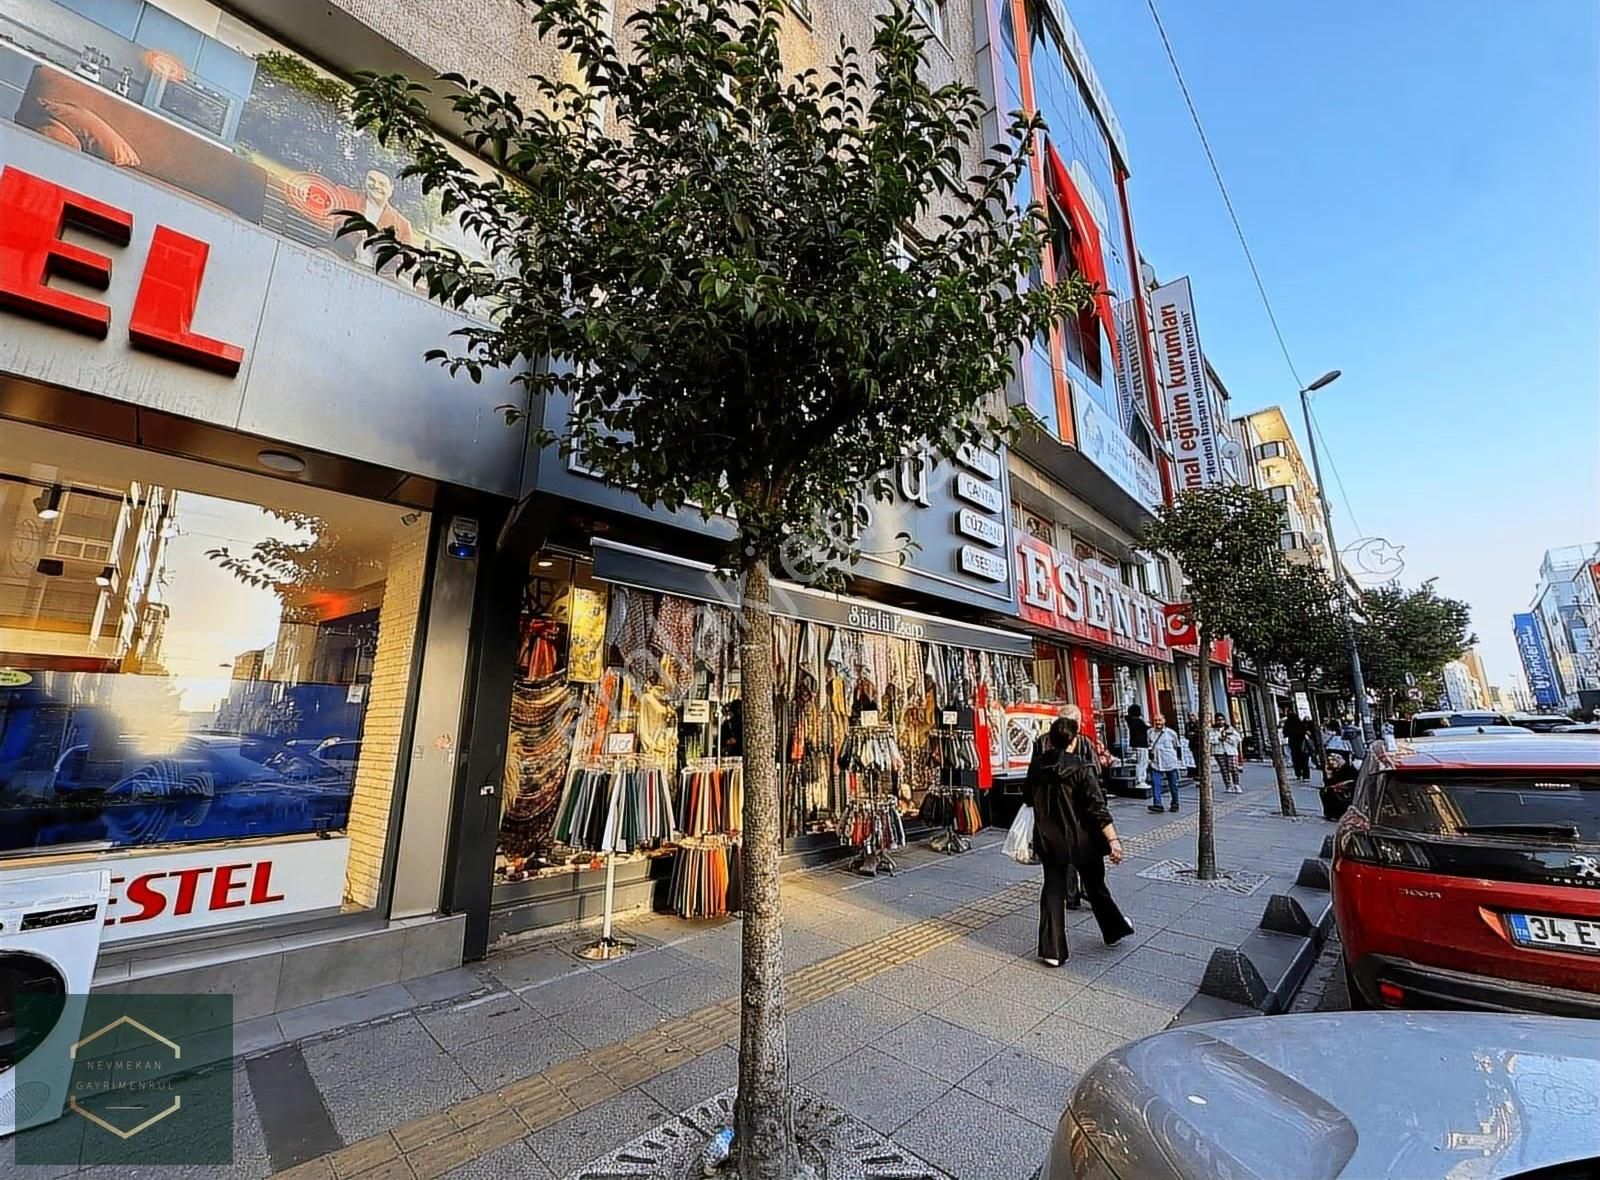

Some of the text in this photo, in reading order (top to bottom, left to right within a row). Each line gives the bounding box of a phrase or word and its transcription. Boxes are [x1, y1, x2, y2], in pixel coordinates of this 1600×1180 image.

[0, 165, 245, 378] EL
[1158, 303, 1187, 389] kurumları
[1171, 392, 1199, 452] eğitim
[966, 480, 996, 506] ÇANTA
[1529, 917, 1567, 942] 34
